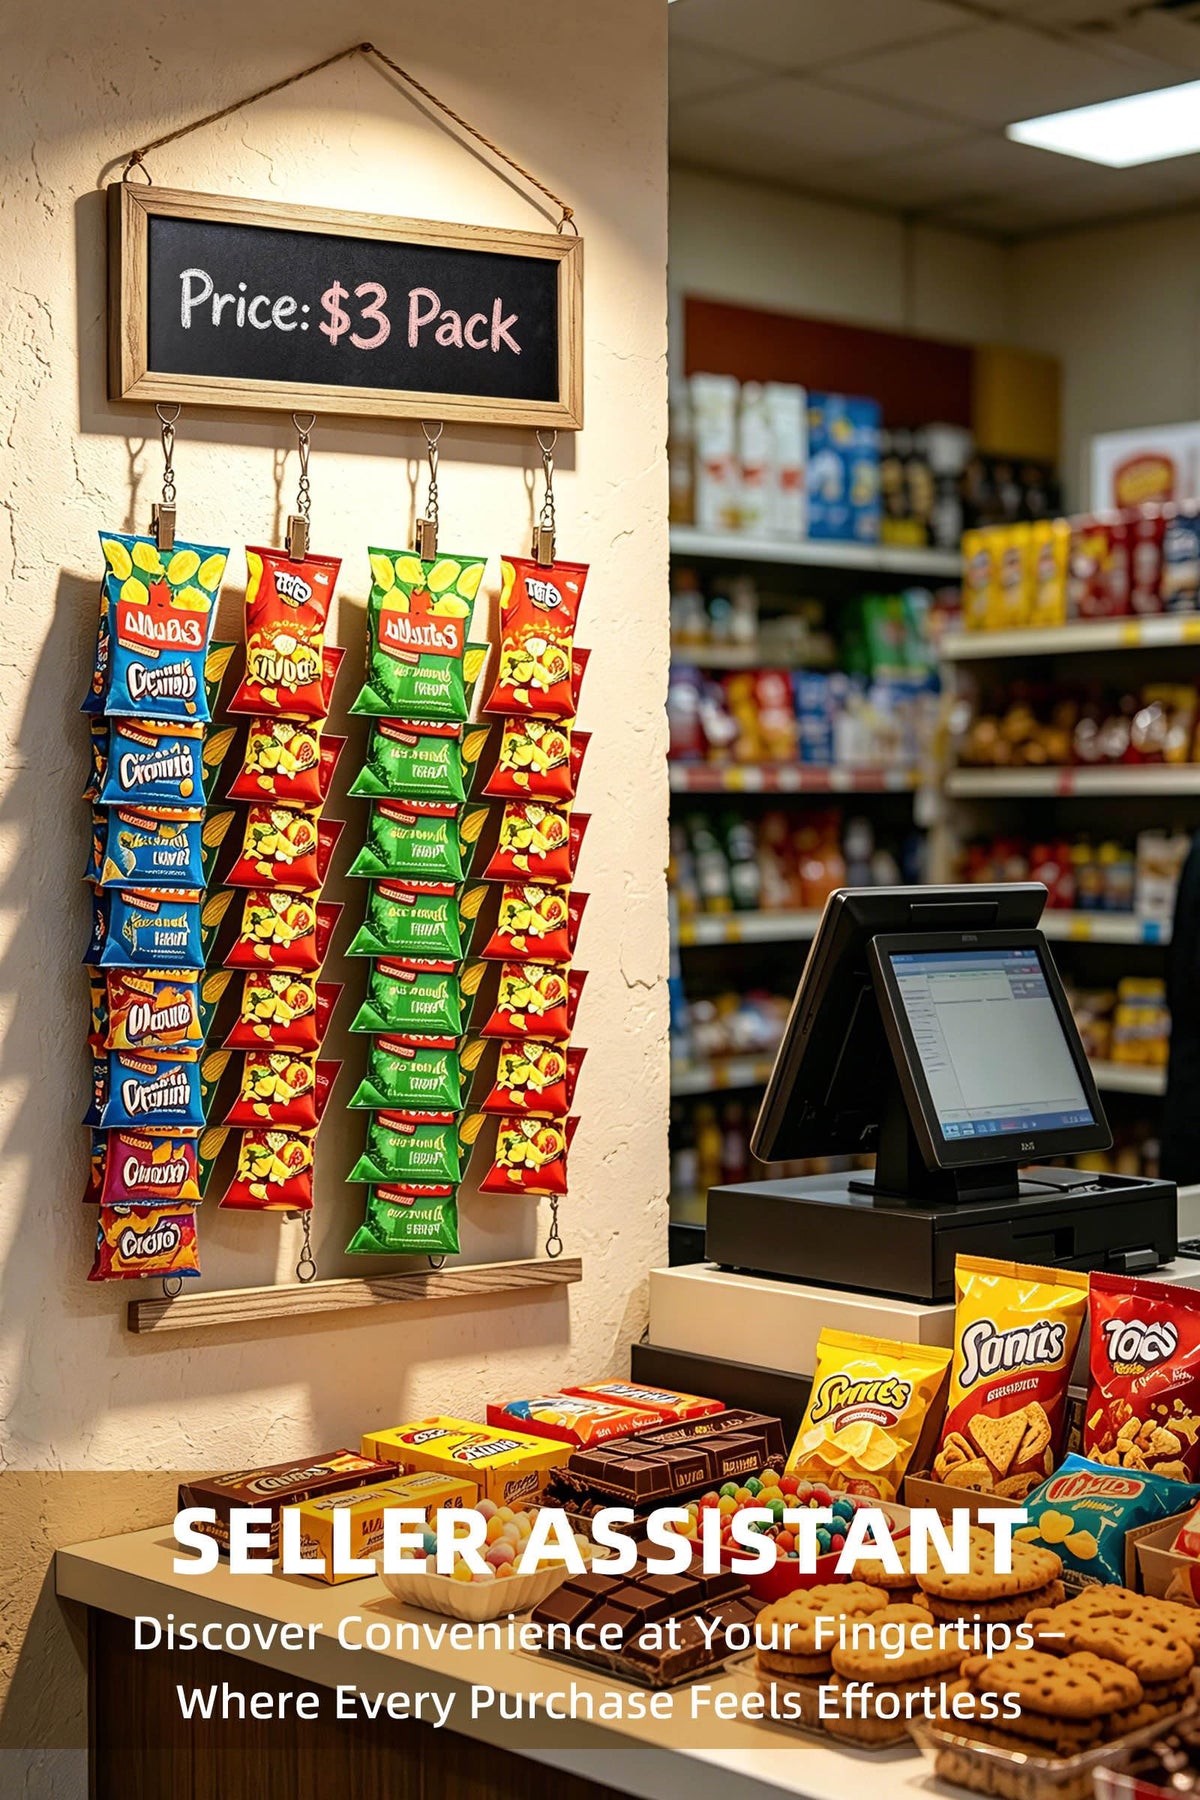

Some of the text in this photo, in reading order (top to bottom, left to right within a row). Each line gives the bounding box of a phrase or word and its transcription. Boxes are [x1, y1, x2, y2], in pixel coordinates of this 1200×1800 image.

[179, 268, 522, 355] Price: $3 Pack
